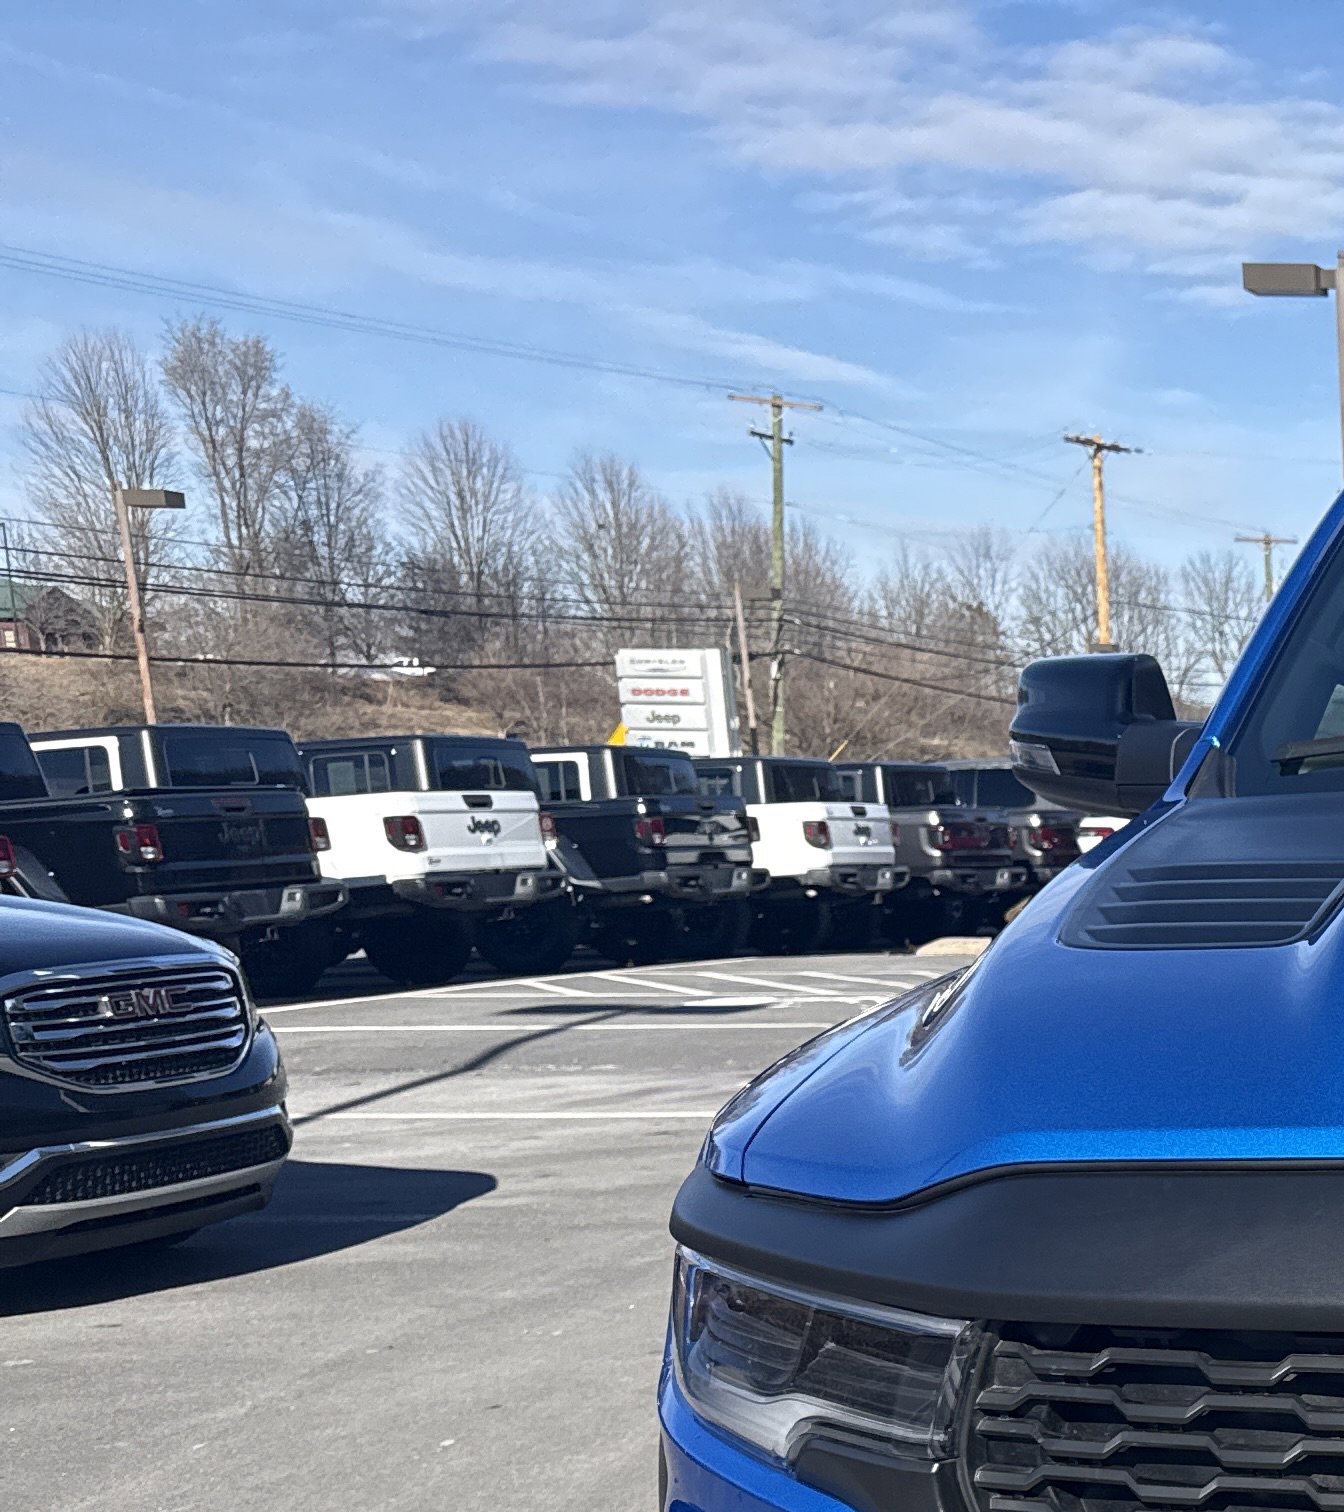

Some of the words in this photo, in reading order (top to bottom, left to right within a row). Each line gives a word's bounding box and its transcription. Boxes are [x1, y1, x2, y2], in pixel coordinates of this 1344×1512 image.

[631, 688, 689, 696] DODGE
[646, 710, 681, 726] Jeep
[467, 815, 501, 837] Jeep
[98, 985, 193, 1020] GMC
